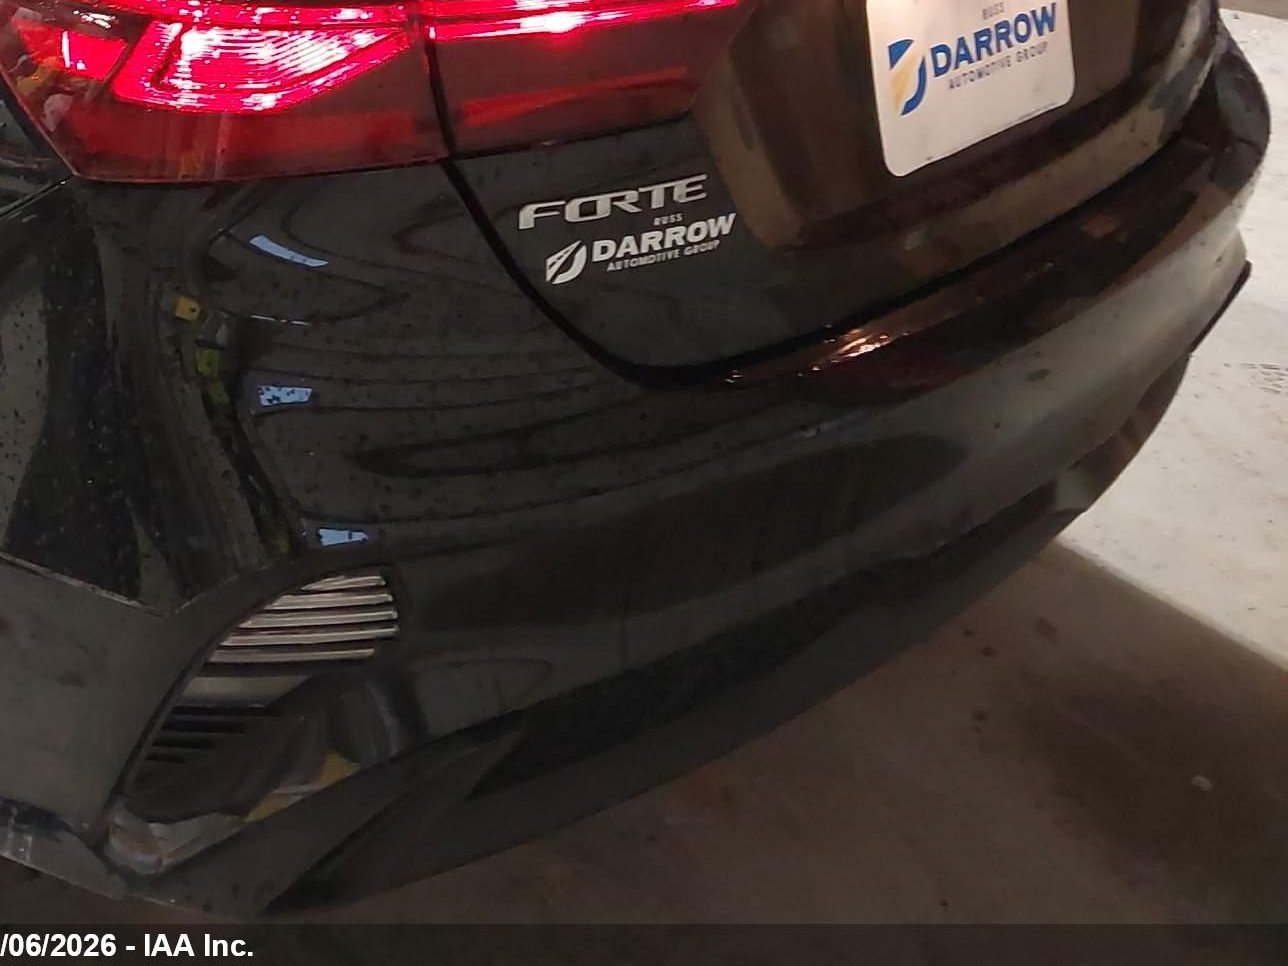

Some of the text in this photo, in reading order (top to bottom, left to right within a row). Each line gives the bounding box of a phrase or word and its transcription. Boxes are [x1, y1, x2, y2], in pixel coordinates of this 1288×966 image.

[982, 1, 1005, 21] RUSS
[929, 2, 1057, 78] DARROW
[948, 41, 1049, 89] AUTOMOTIVE GROUP
[519, 174, 708, 230] FORTE
[654, 213, 683, 226] RUSS
[592, 213, 736, 262] DARROW
[606, 239, 720, 272] AUTOMOTIVE GROUP
